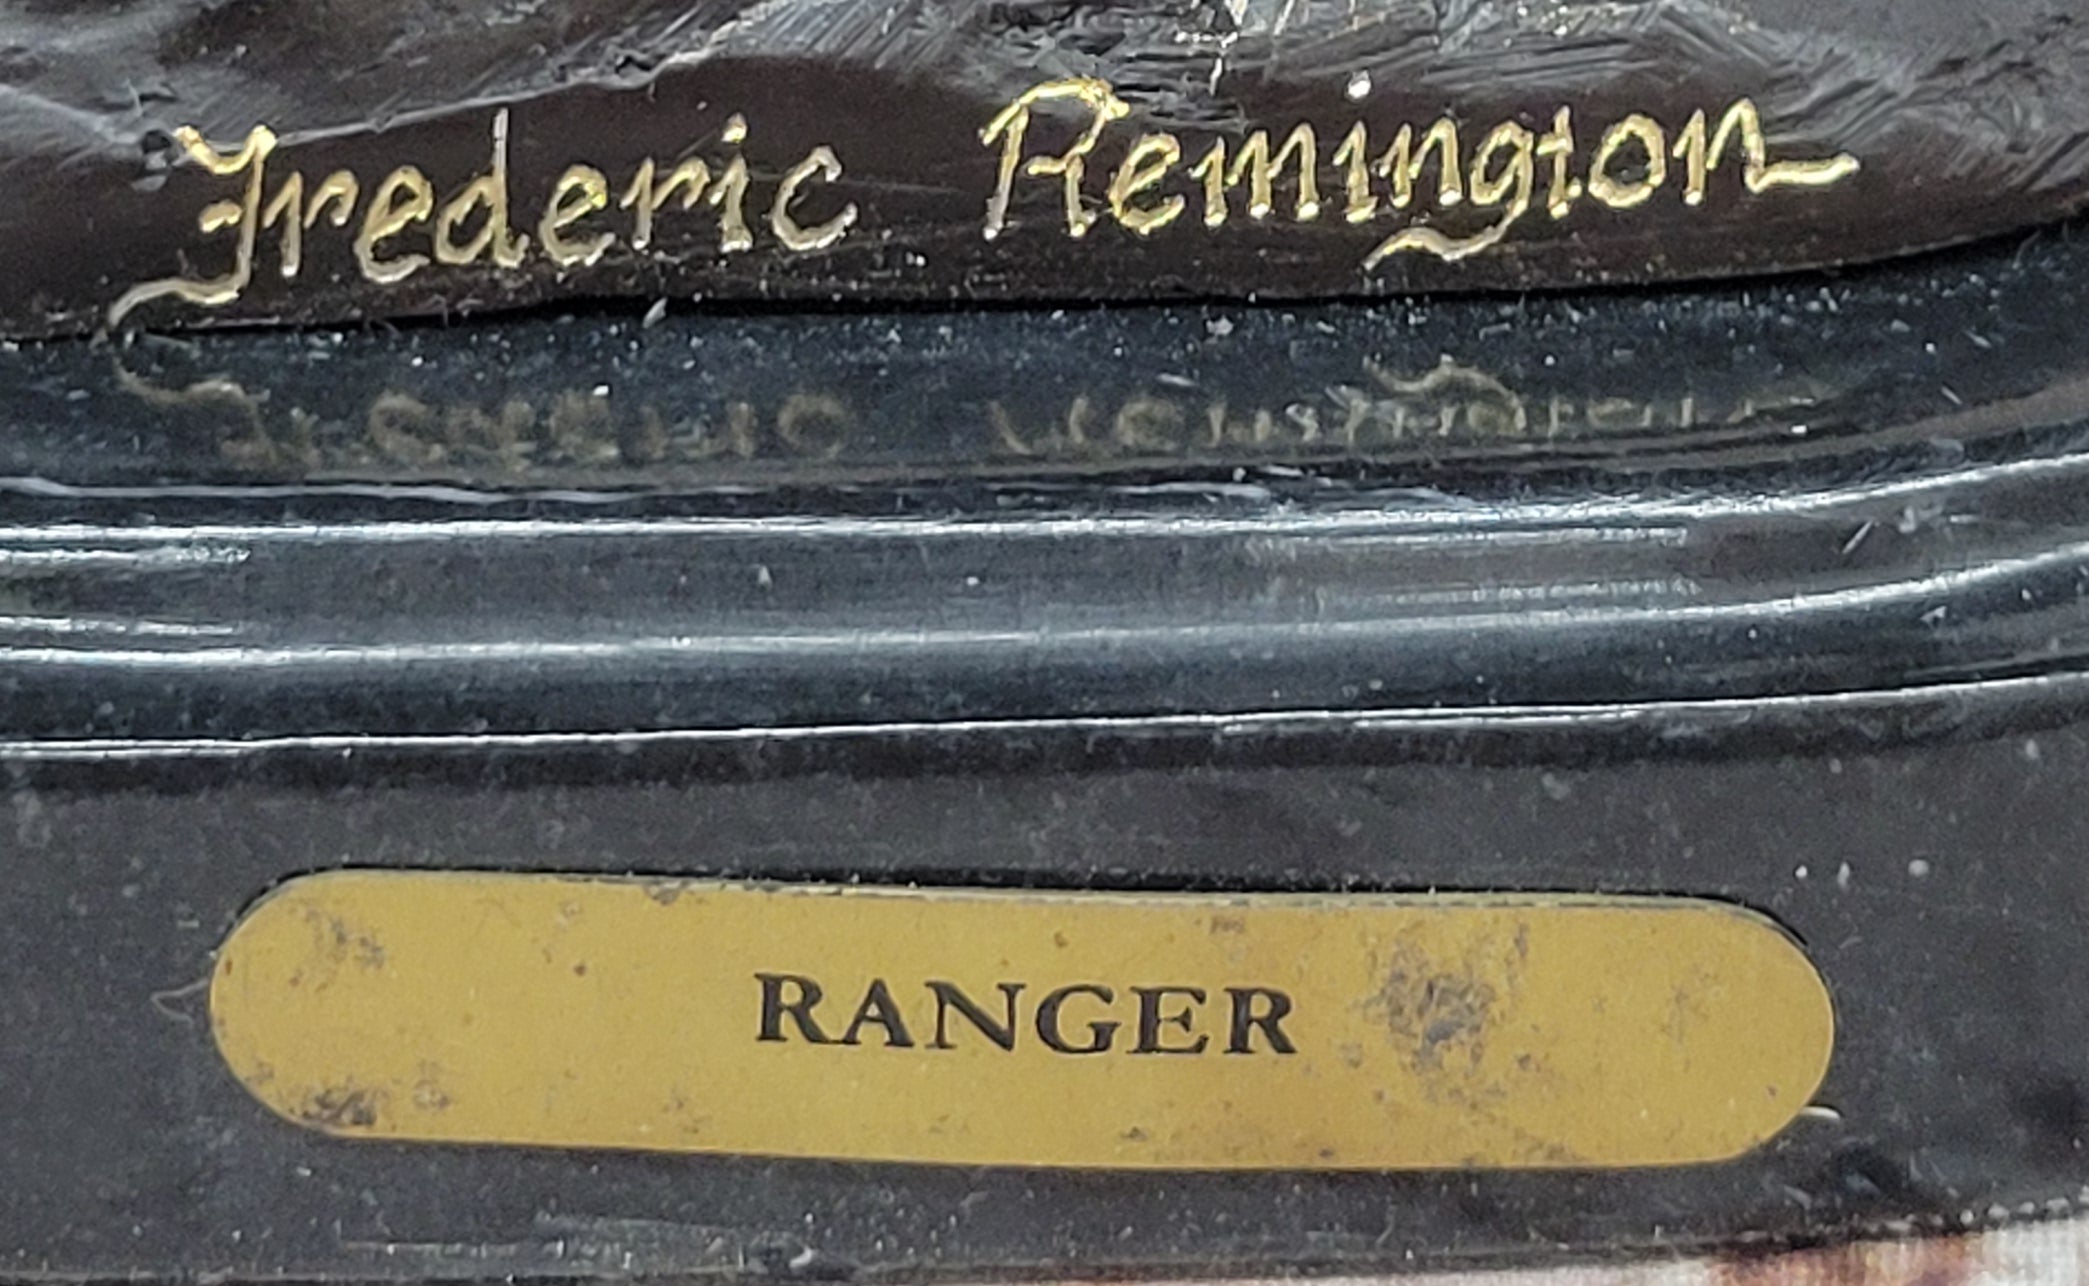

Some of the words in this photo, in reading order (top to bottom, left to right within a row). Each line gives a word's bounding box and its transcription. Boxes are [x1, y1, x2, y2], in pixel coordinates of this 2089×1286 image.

[107, 109, 857, 328] Frederic
[980, 76, 1860, 269] Remington
[755, 972, 1298, 1056] RANGER
